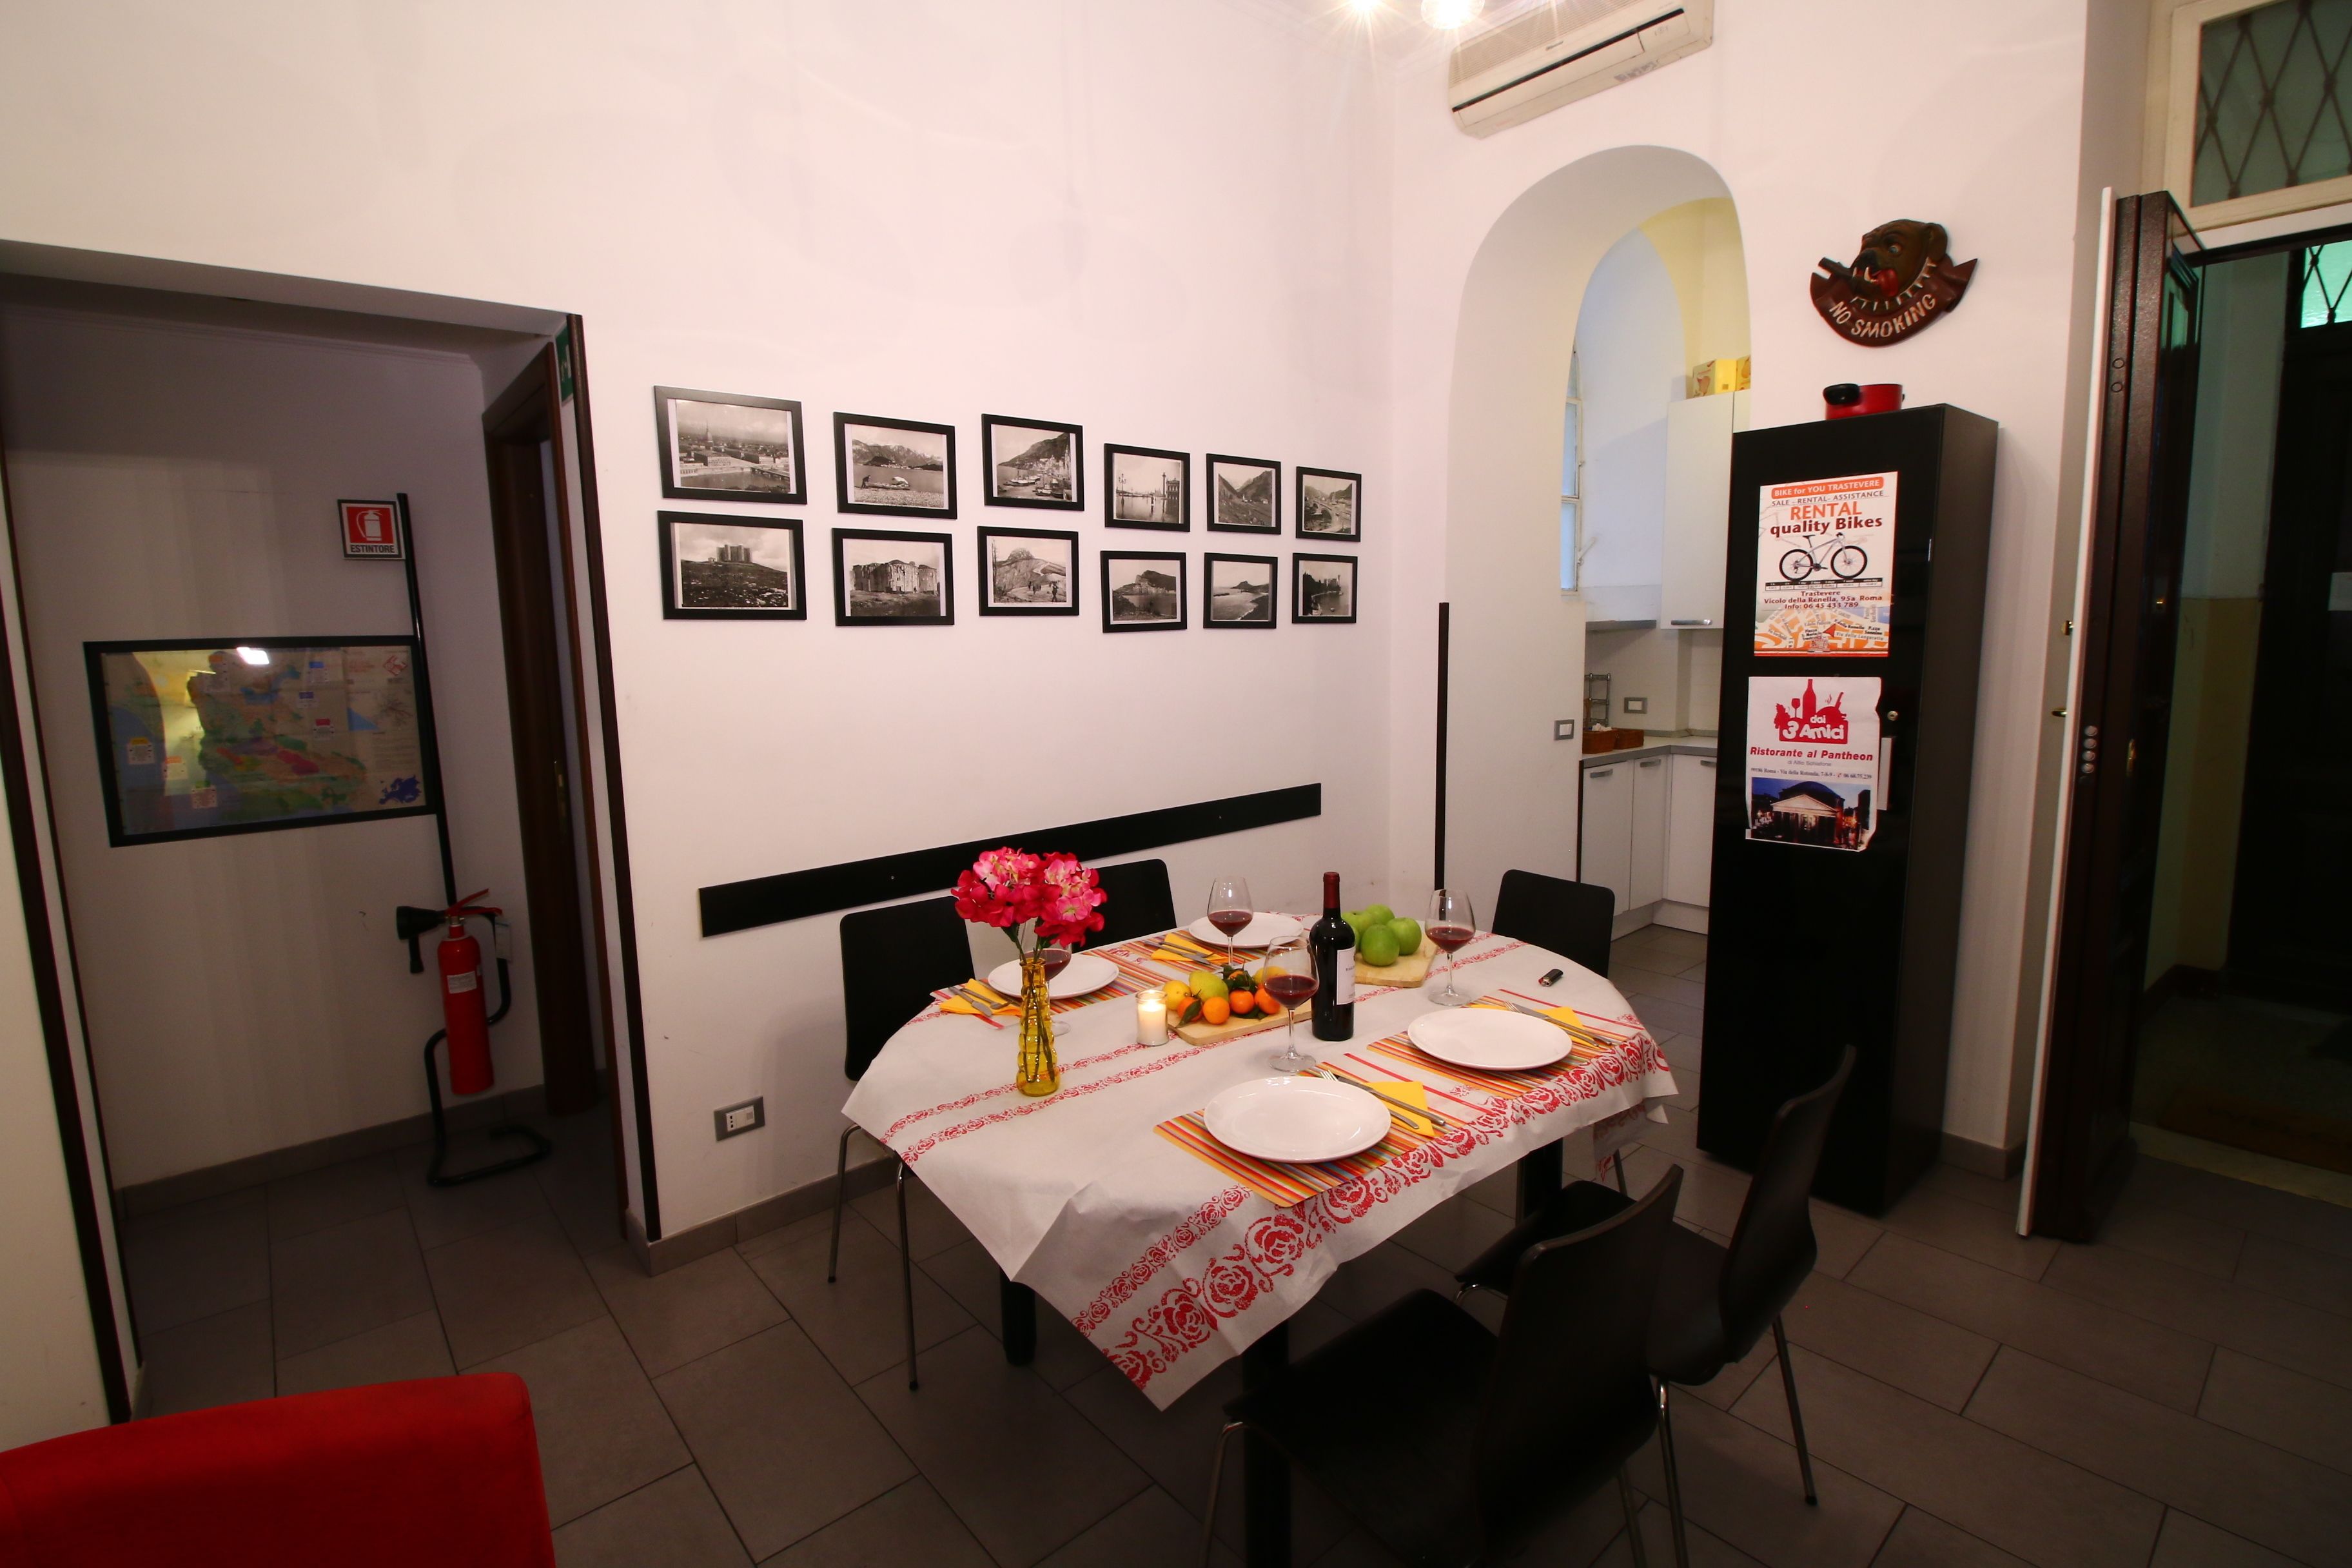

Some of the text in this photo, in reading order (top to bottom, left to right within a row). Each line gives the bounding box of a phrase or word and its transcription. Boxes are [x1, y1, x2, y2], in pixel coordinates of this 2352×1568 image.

[1829, 294, 1936, 338] NO SMOKING
[1774, 488, 1792, 496] BIKE
[1807, 485, 1825, 493] YOU
[1828, 479, 1880, 491] TRASTEVERE
[1833, 490, 1883, 500] ASSISTANCE
[1790, 500, 1862, 520] RENTAL
[1770, 516, 1883, 538] quality Bikes
[351, 545, 395, 553] ESTINTORE
[1810, 714, 1826, 723] dai
[1782, 720, 1844, 740] 3 Amici
[1750, 747, 1873, 761] Ristorante al Pantheon
